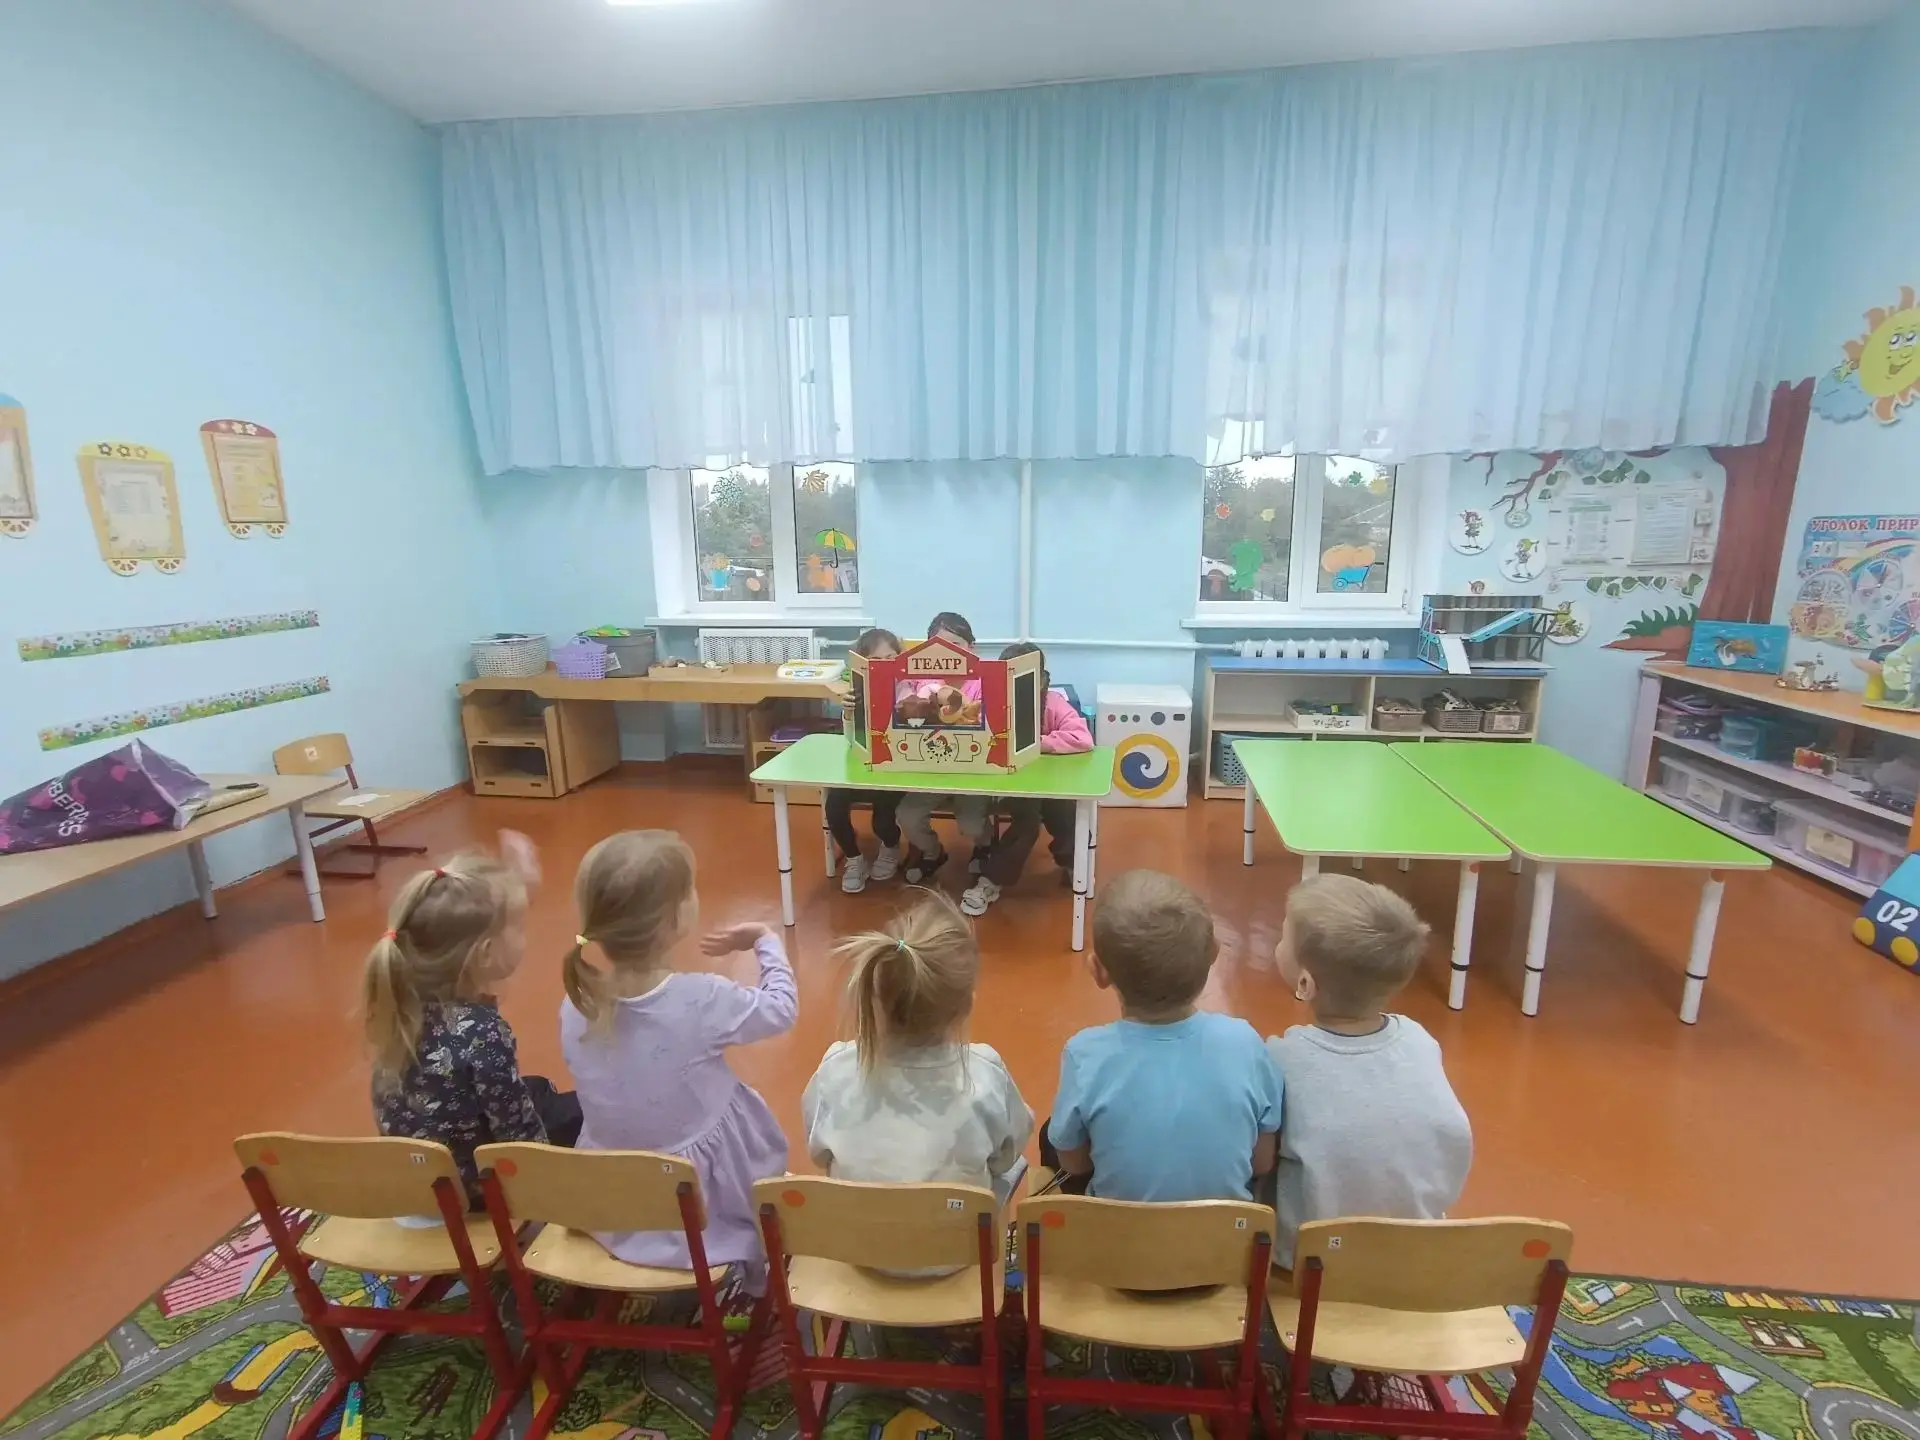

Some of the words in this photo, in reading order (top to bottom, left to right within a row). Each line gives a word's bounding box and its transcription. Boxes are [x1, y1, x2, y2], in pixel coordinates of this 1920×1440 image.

[1811, 519, 1868, 531] УГОЛОК
[911, 657, 962, 670] ТЕАТР
[1876, 900, 1919, 932] 02
